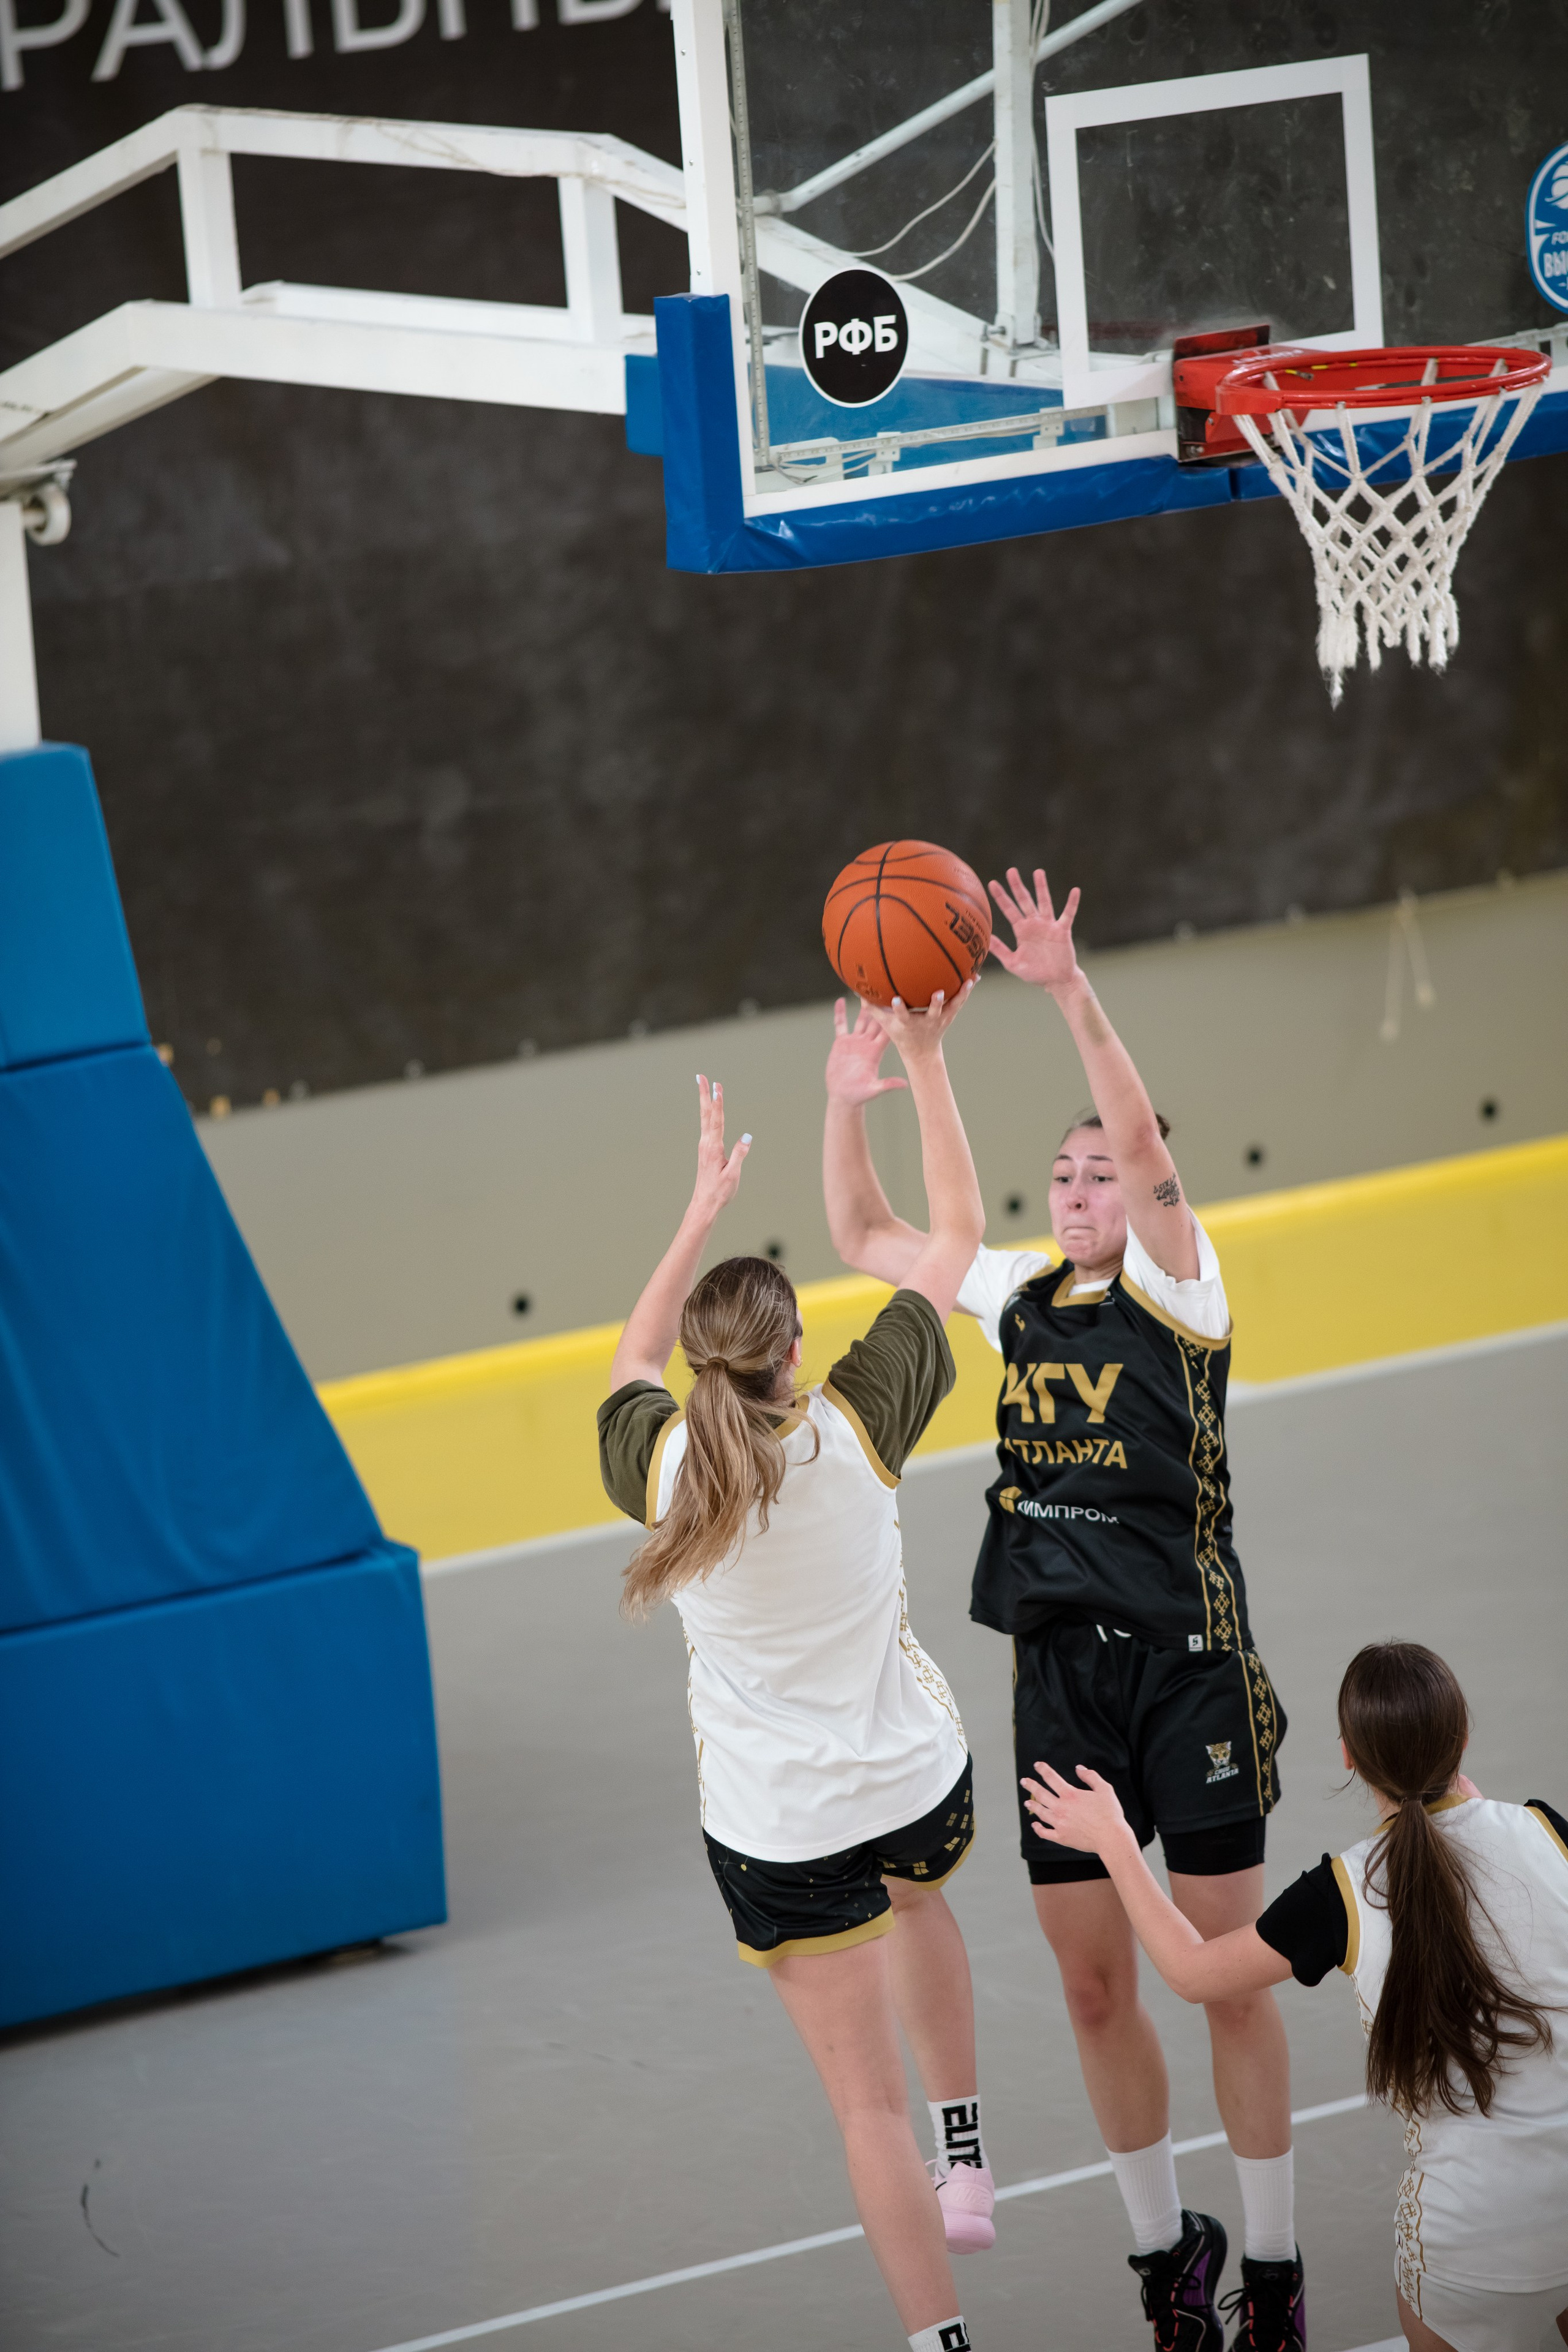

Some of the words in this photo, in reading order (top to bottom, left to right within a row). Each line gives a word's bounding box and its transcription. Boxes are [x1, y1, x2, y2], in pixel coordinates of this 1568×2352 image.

[1551, 231, 1568, 245] FO
[1544, 251, 1568, 278] ВЫ
[814, 315, 899, 359] РФБ
[1205, 1768, 1239, 1784] ATLANTA
